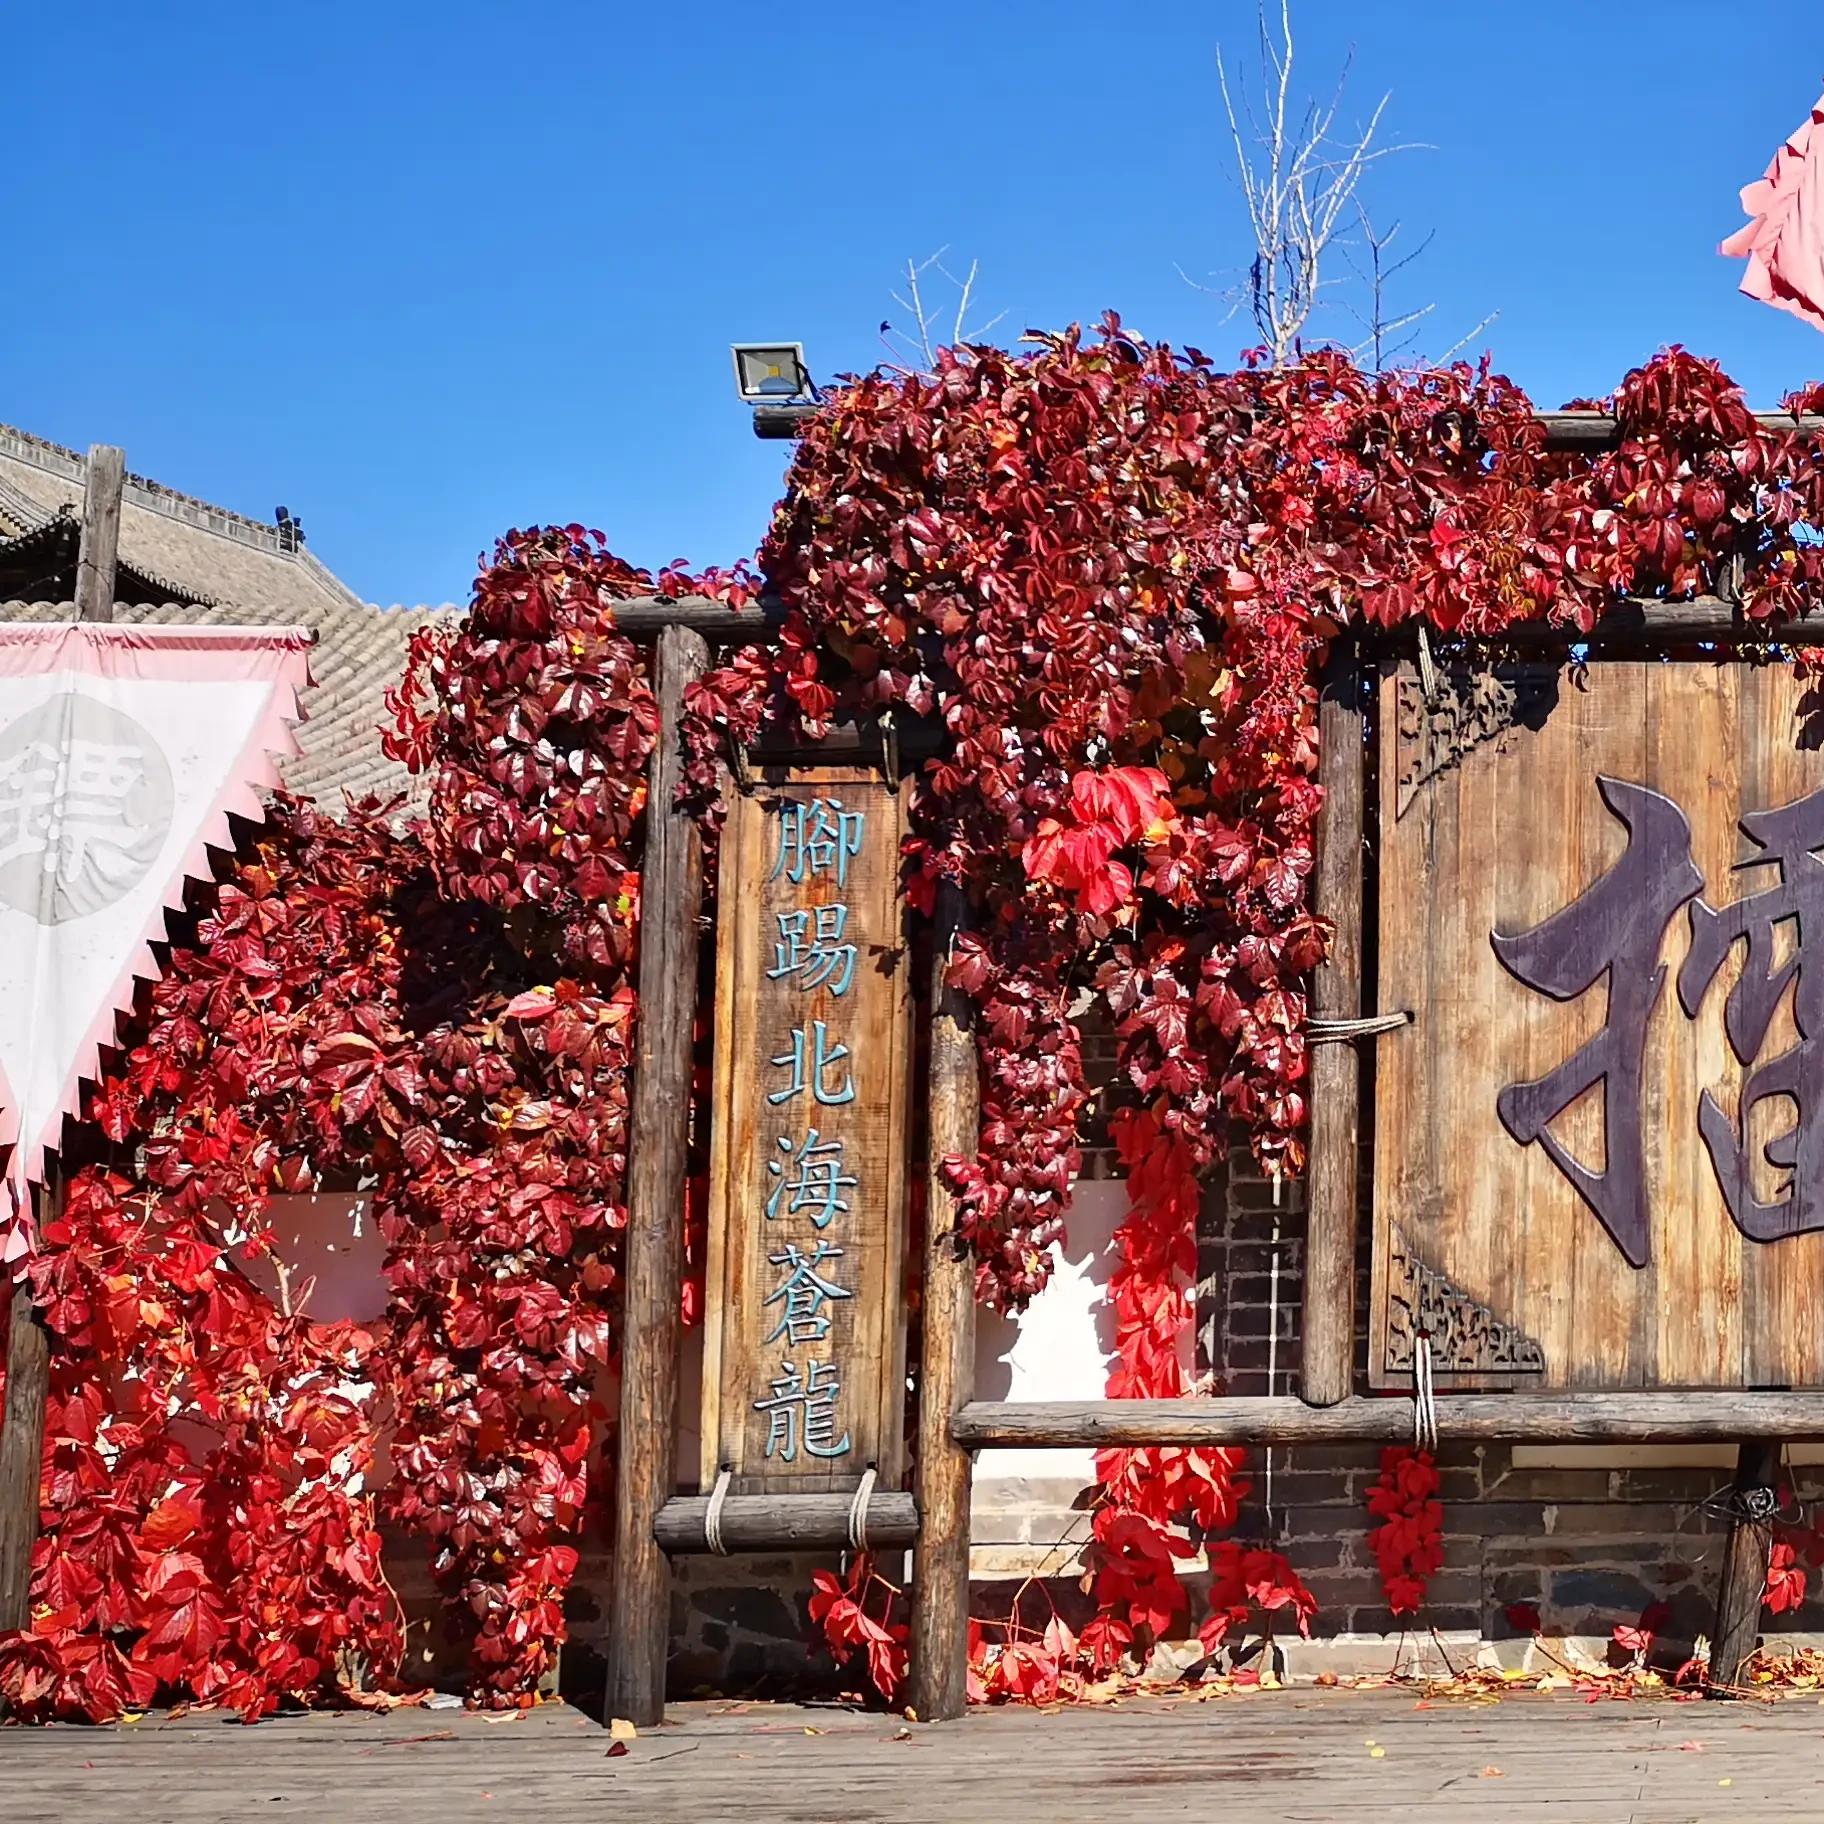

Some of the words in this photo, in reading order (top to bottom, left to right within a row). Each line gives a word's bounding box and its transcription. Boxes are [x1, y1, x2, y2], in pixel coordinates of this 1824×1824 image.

[754, 797, 865, 1461] 腳踢北海蒼龍
